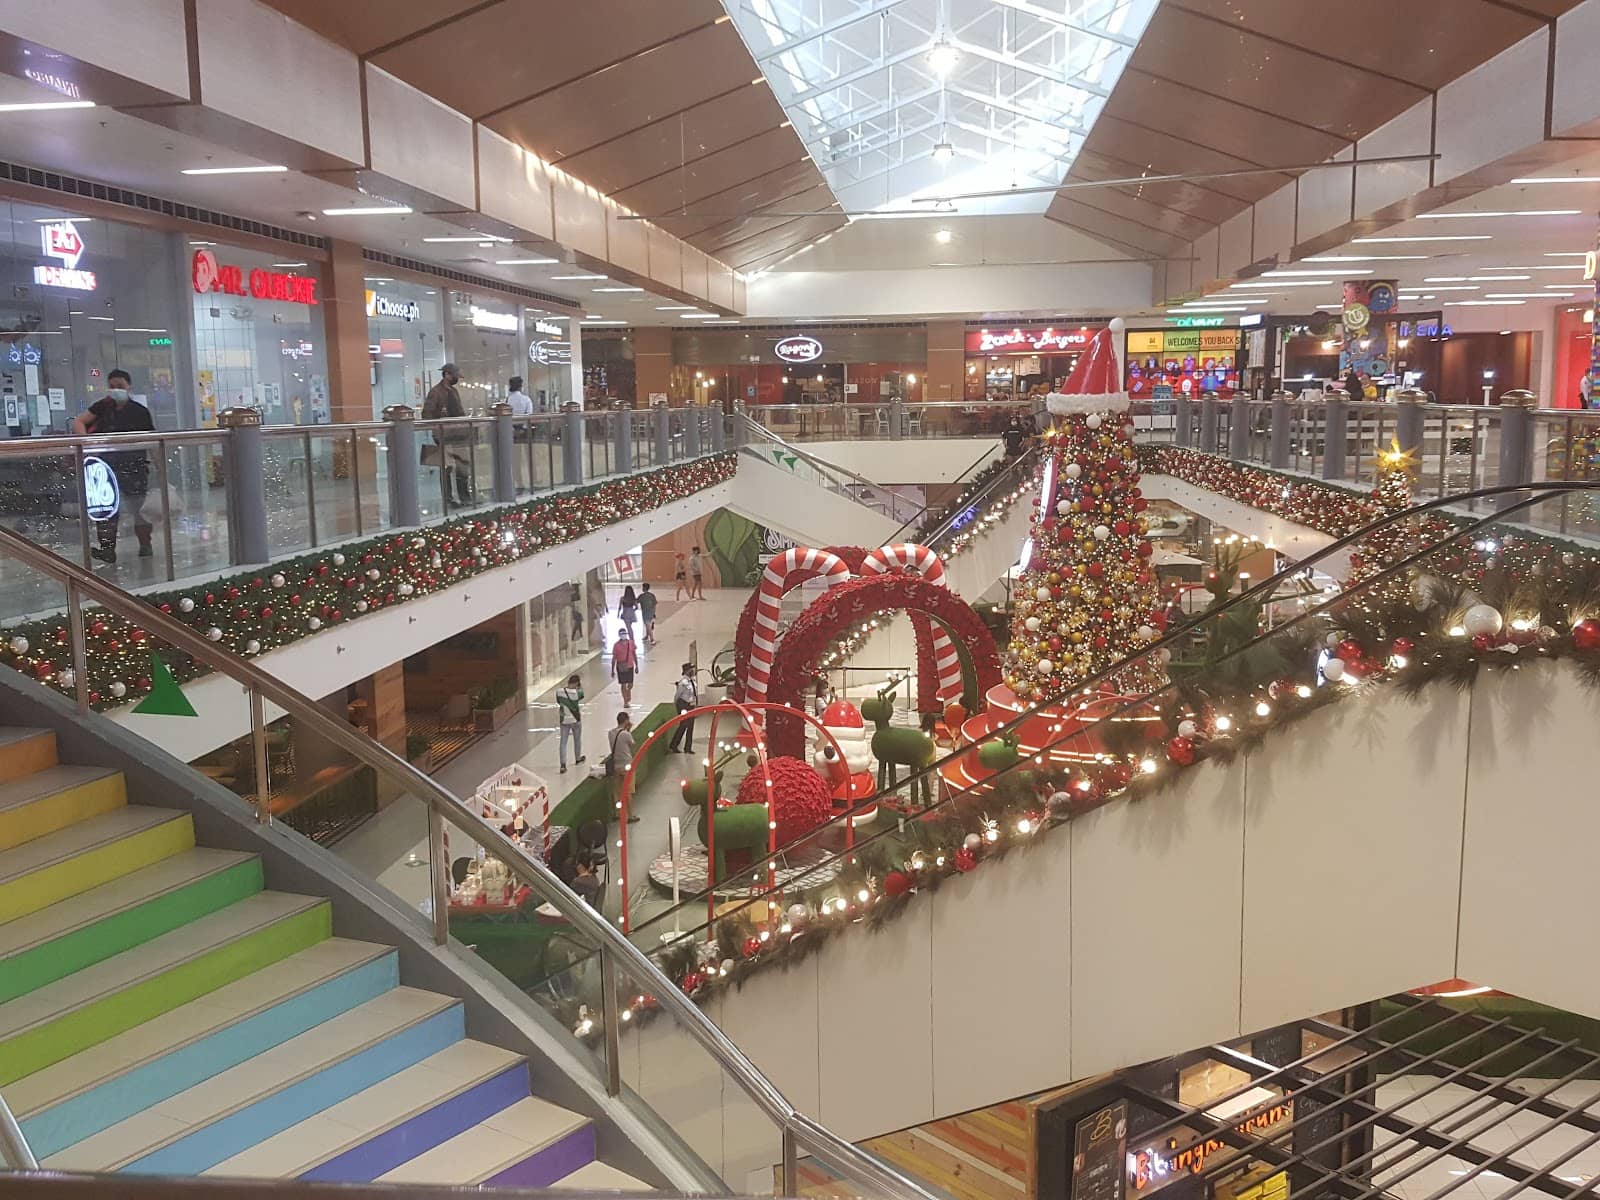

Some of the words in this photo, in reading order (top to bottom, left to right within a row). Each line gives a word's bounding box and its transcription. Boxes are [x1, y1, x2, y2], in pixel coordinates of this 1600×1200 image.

[376, 295, 420, 323] iChoose.ph
[1167, 336, 1203, 347] WELCOMES
[1203, 336, 1217, 345] YOU
[1217, 335, 1235, 345] BACK
